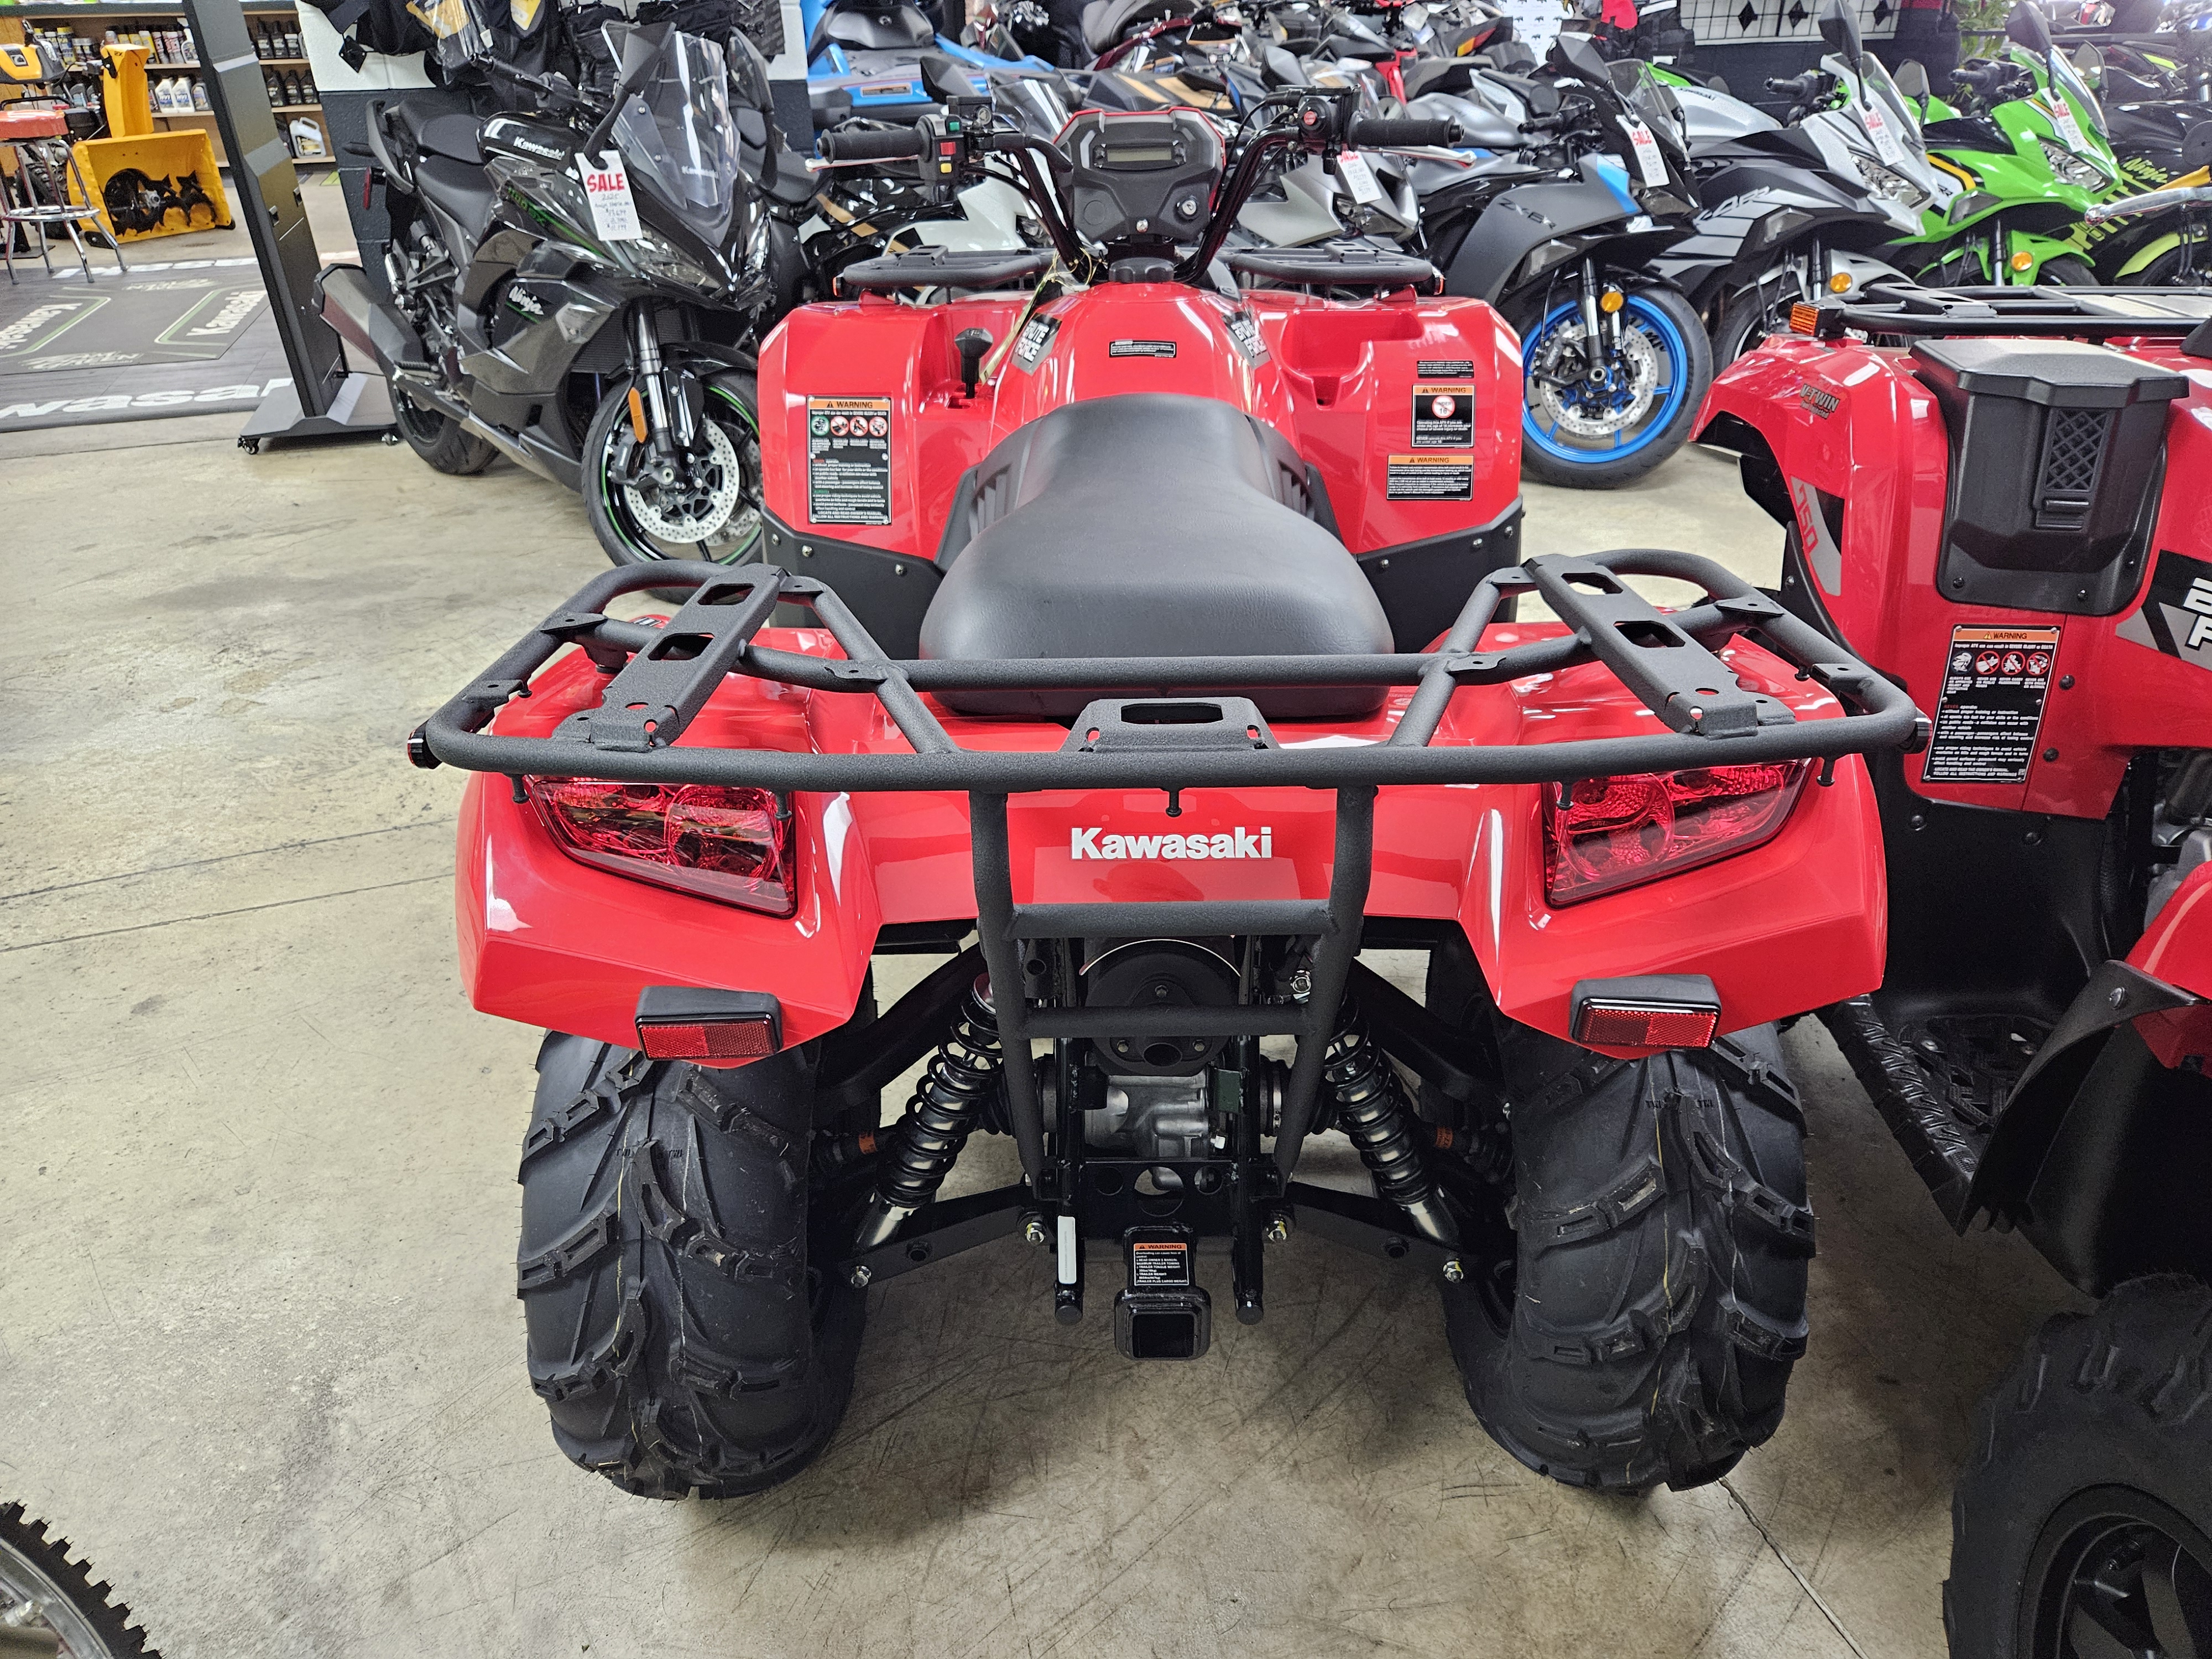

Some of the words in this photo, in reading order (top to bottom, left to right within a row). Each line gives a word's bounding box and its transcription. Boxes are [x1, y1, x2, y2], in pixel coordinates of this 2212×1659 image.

[513, 136, 565, 161] Kawasaki
[1632, 131, 1652, 145] SALE
[587, 173, 625, 193] SALE
[2122, 157, 2168, 184] Ninja
[509, 285, 544, 315] Ninja
[1799, 383, 1840, 413] V-TWIN
[1797, 483, 1818, 554] 750
[1071, 826, 1272, 859] Kawasaki
